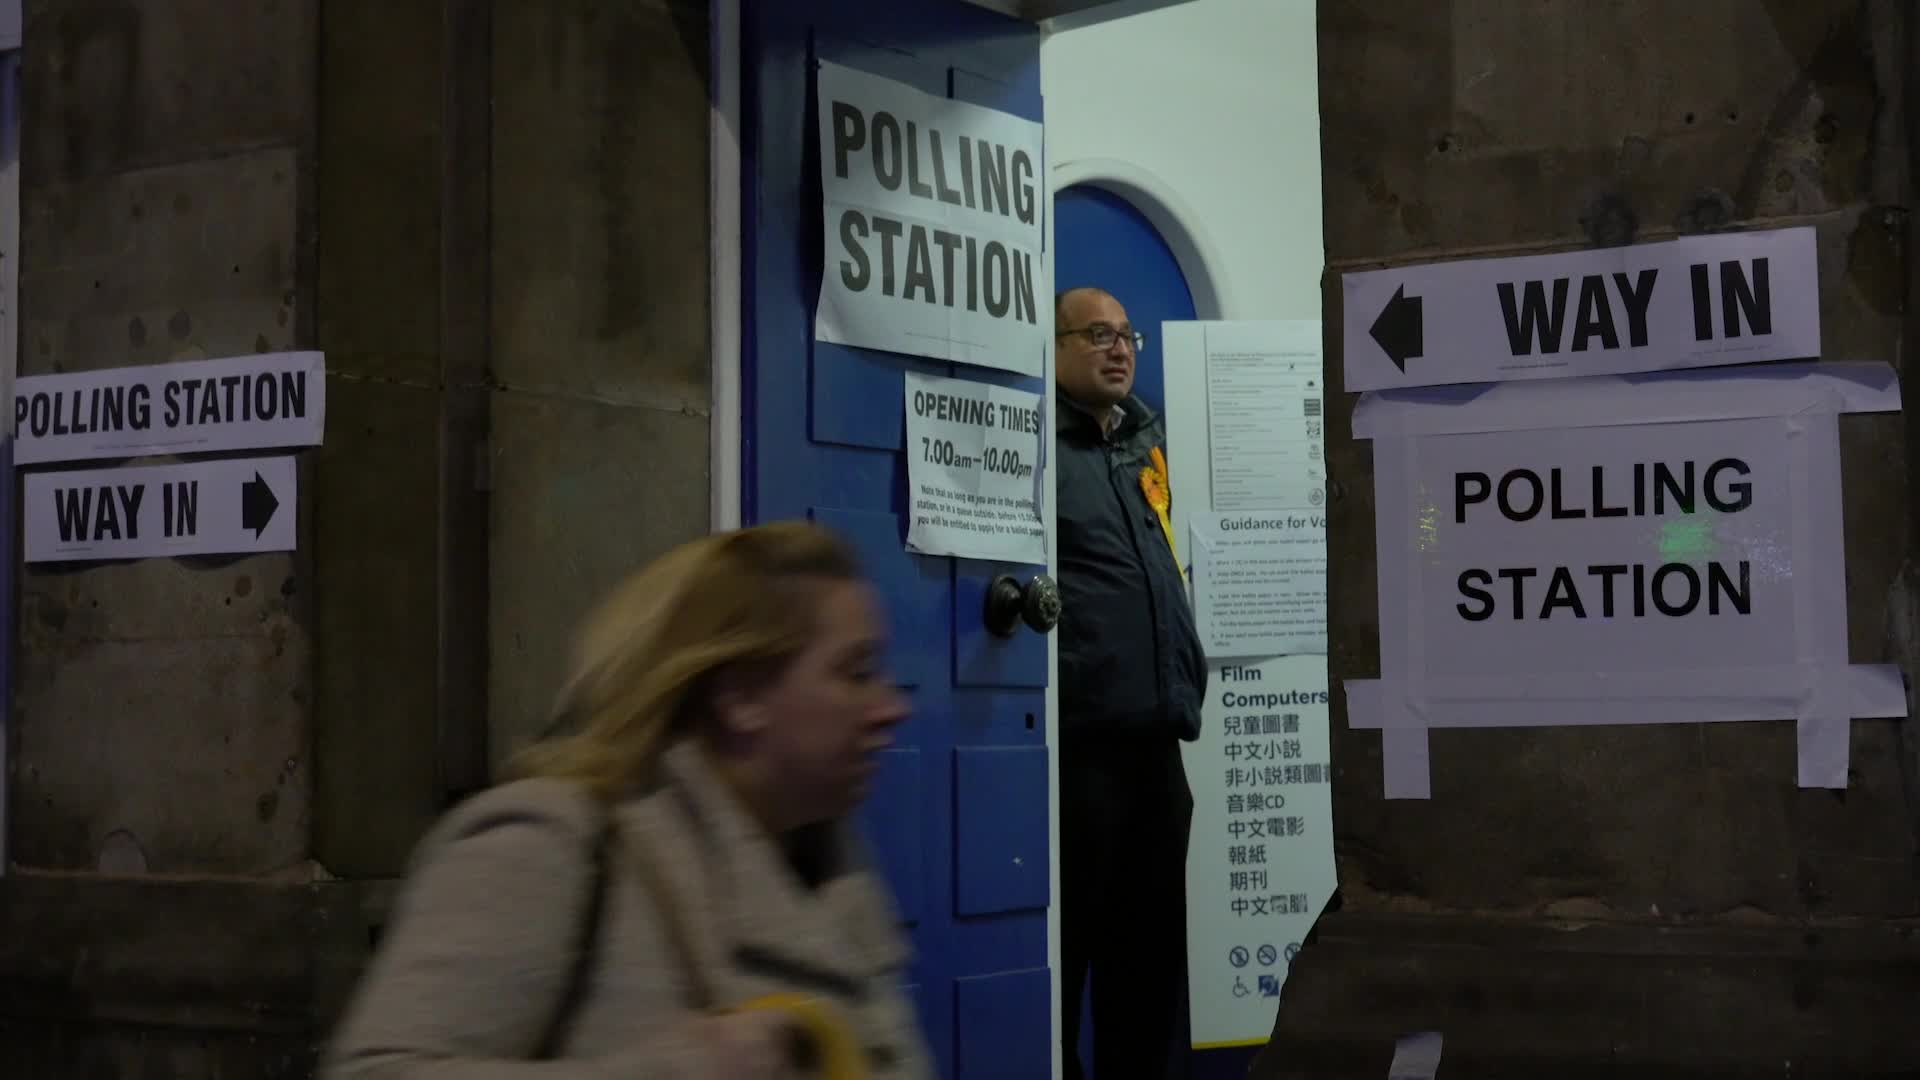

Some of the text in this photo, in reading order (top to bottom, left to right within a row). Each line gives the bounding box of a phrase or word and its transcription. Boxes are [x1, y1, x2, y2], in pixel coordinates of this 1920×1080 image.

[832, 100, 1035, 226] POLLING
[839, 210, 1037, 325] STATION
[1496, 258, 1772, 356] WAY IN
[15, 371, 306, 439] POLLING STATION
[914, 390, 1039, 435] OPENING TIMES
[976, 496, 986, 507] you
[1454, 458, 1753, 524] POLLING
[55, 480, 198, 542] WAY IN
[917, 516, 930, 527] you
[1220, 518, 1283, 531] Guidance
[1287, 517, 1306, 529] for
[1455, 560, 1751, 621] STATION
[1221, 666, 1262, 682] Film
[1222, 690, 1329, 710] Computers
[1224, 714, 1300, 736] 兒童圖書
[1226, 793, 1285, 814] 音樂CD
[1228, 816, 1305, 840] 中文電影
[1228, 844, 1267, 865] 報紙
[1229, 870, 1268, 891] 期刊
